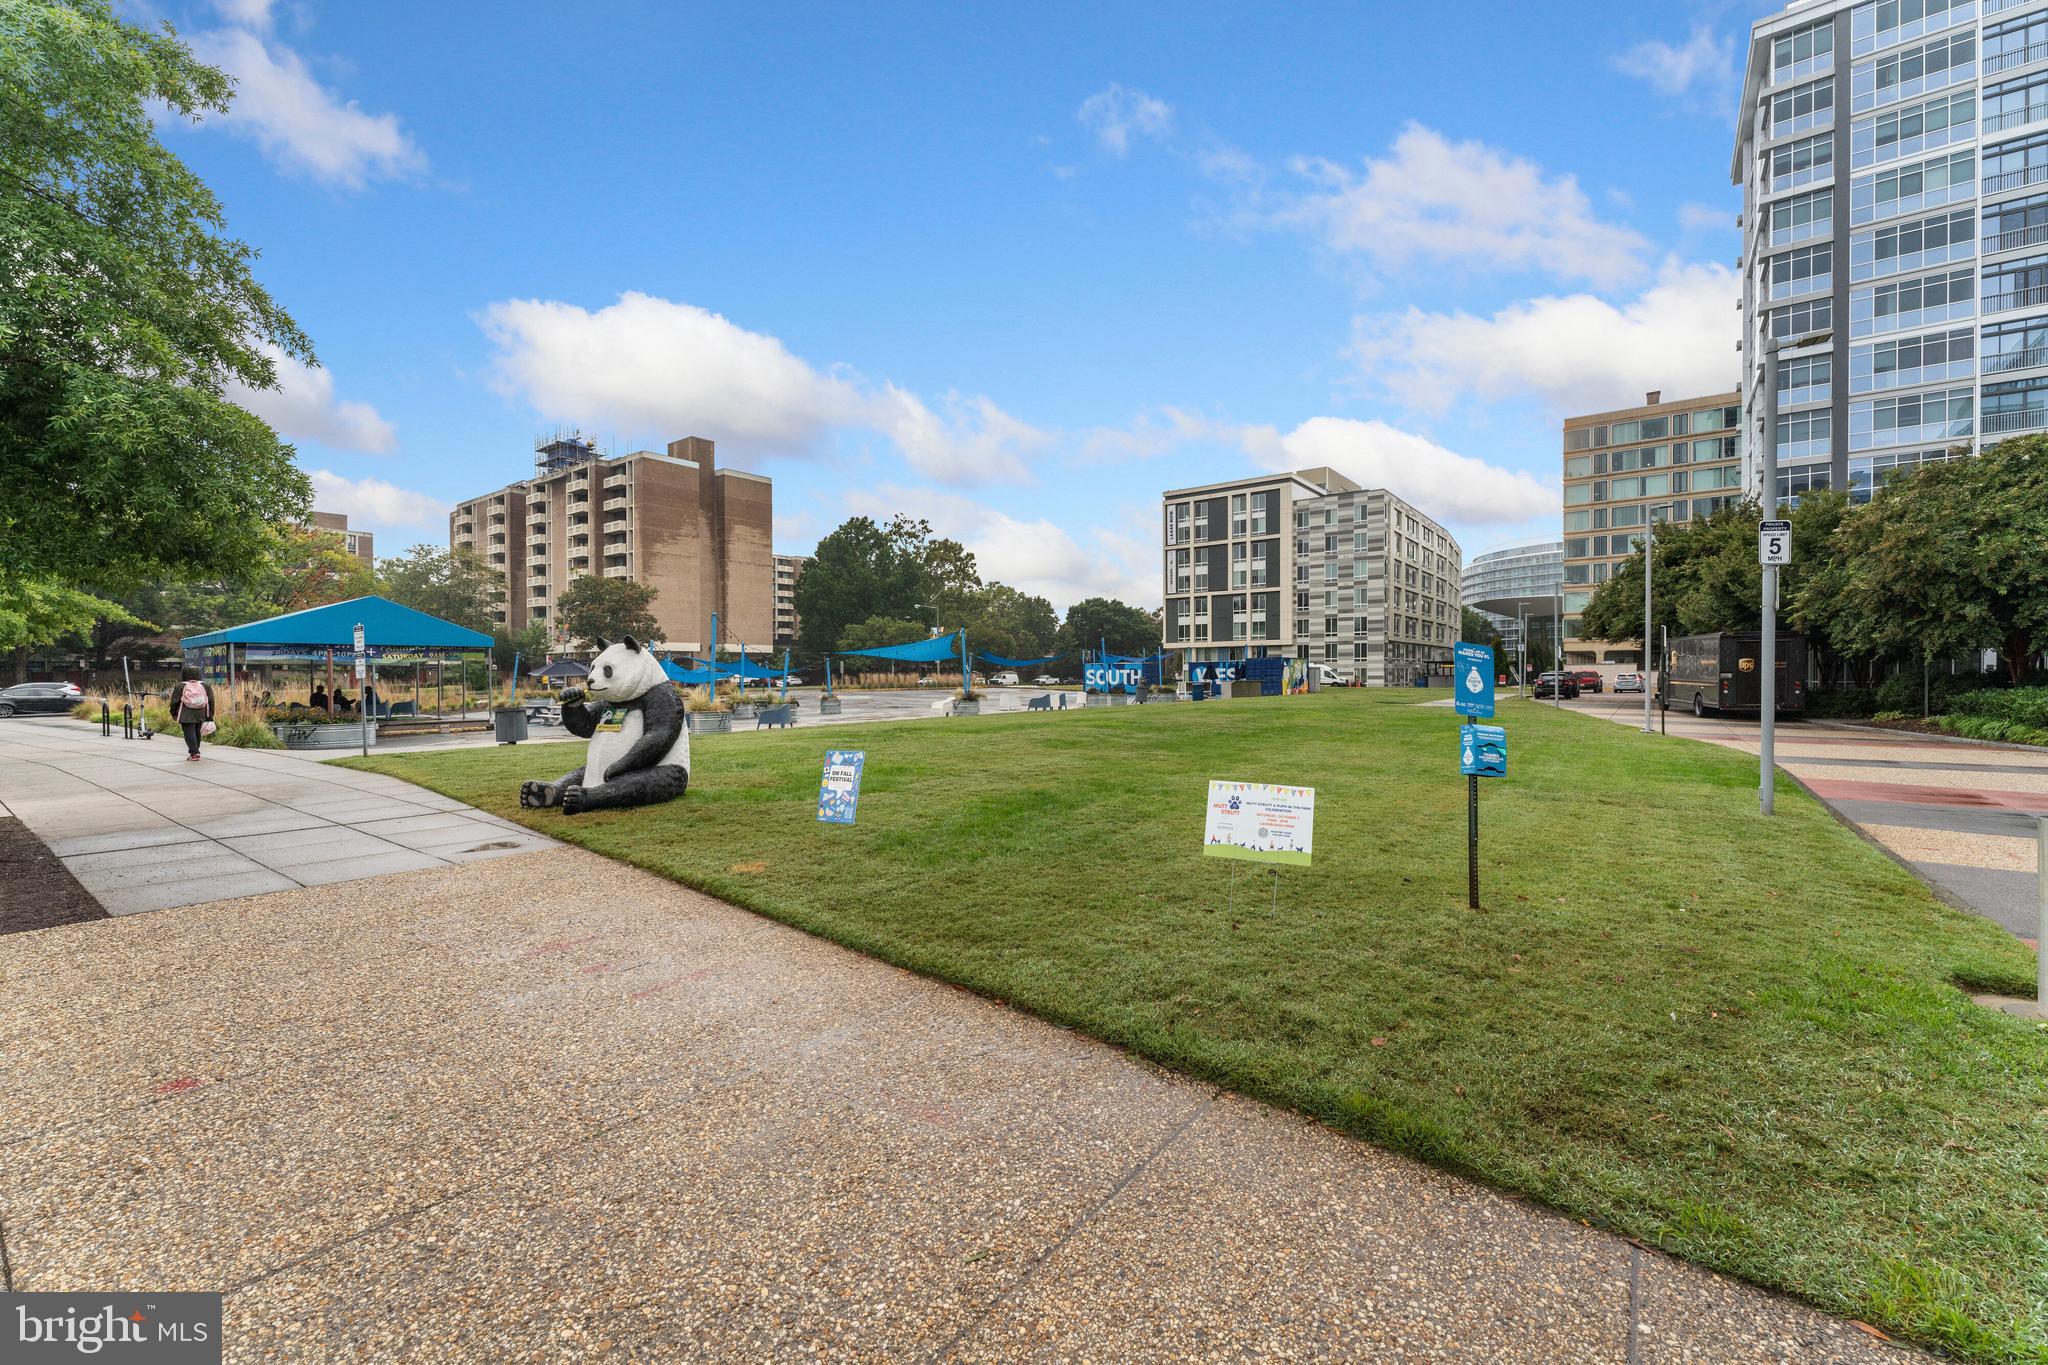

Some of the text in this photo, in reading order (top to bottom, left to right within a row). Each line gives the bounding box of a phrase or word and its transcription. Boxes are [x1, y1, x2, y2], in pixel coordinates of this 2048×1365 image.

[1769, 537, 1782, 554] 5
[382, 652, 424, 660] SATURDAY
[1739, 662, 1753, 671] ups
[1086, 669, 1142, 685] SOUTH
